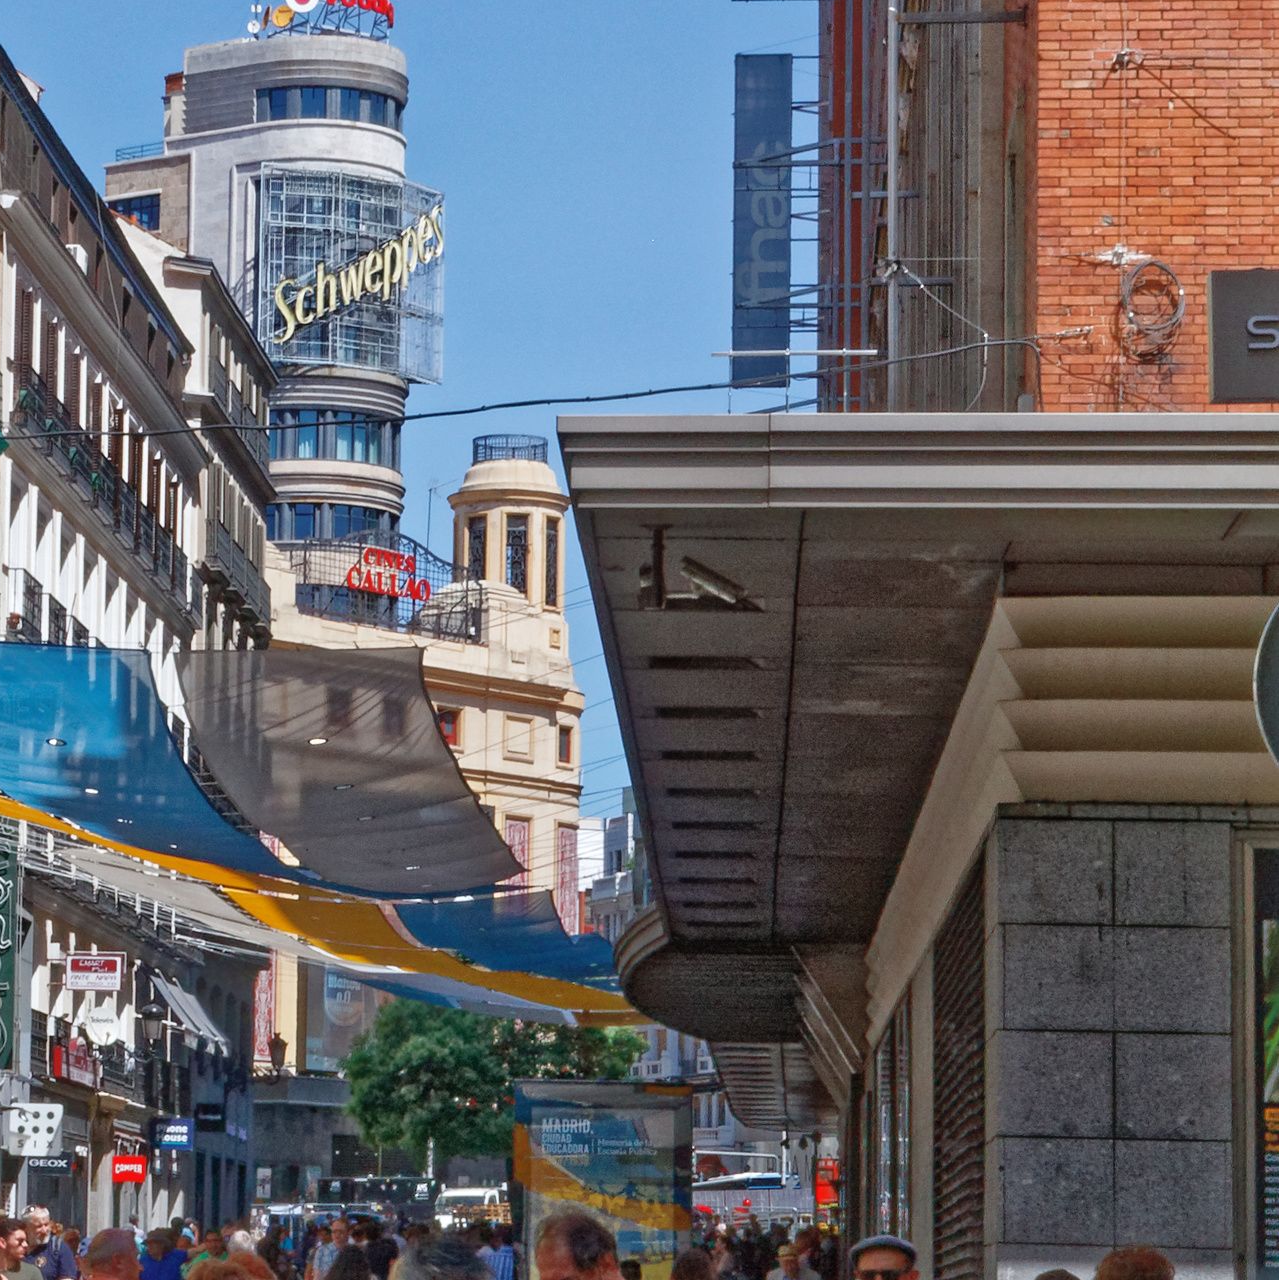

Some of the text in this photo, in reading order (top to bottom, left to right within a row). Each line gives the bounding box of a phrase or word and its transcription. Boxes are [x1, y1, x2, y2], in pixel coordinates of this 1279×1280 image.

[735, 138, 788, 308] fnac
[273, 204, 444, 345] Schweppes
[363, 546, 417, 574] CINES
[346, 565, 431, 603] CALLAO
[156, 1124, 188, 1134] Phone
[17, 1139, 54, 1149] SIX
[542, 1134, 572, 1144] CIUDAD
[542, 1143, 590, 1154] EDUCADORA
[28, 1158, 68, 1168] GEOX
[114, 1162, 143, 1175] CAMPER
